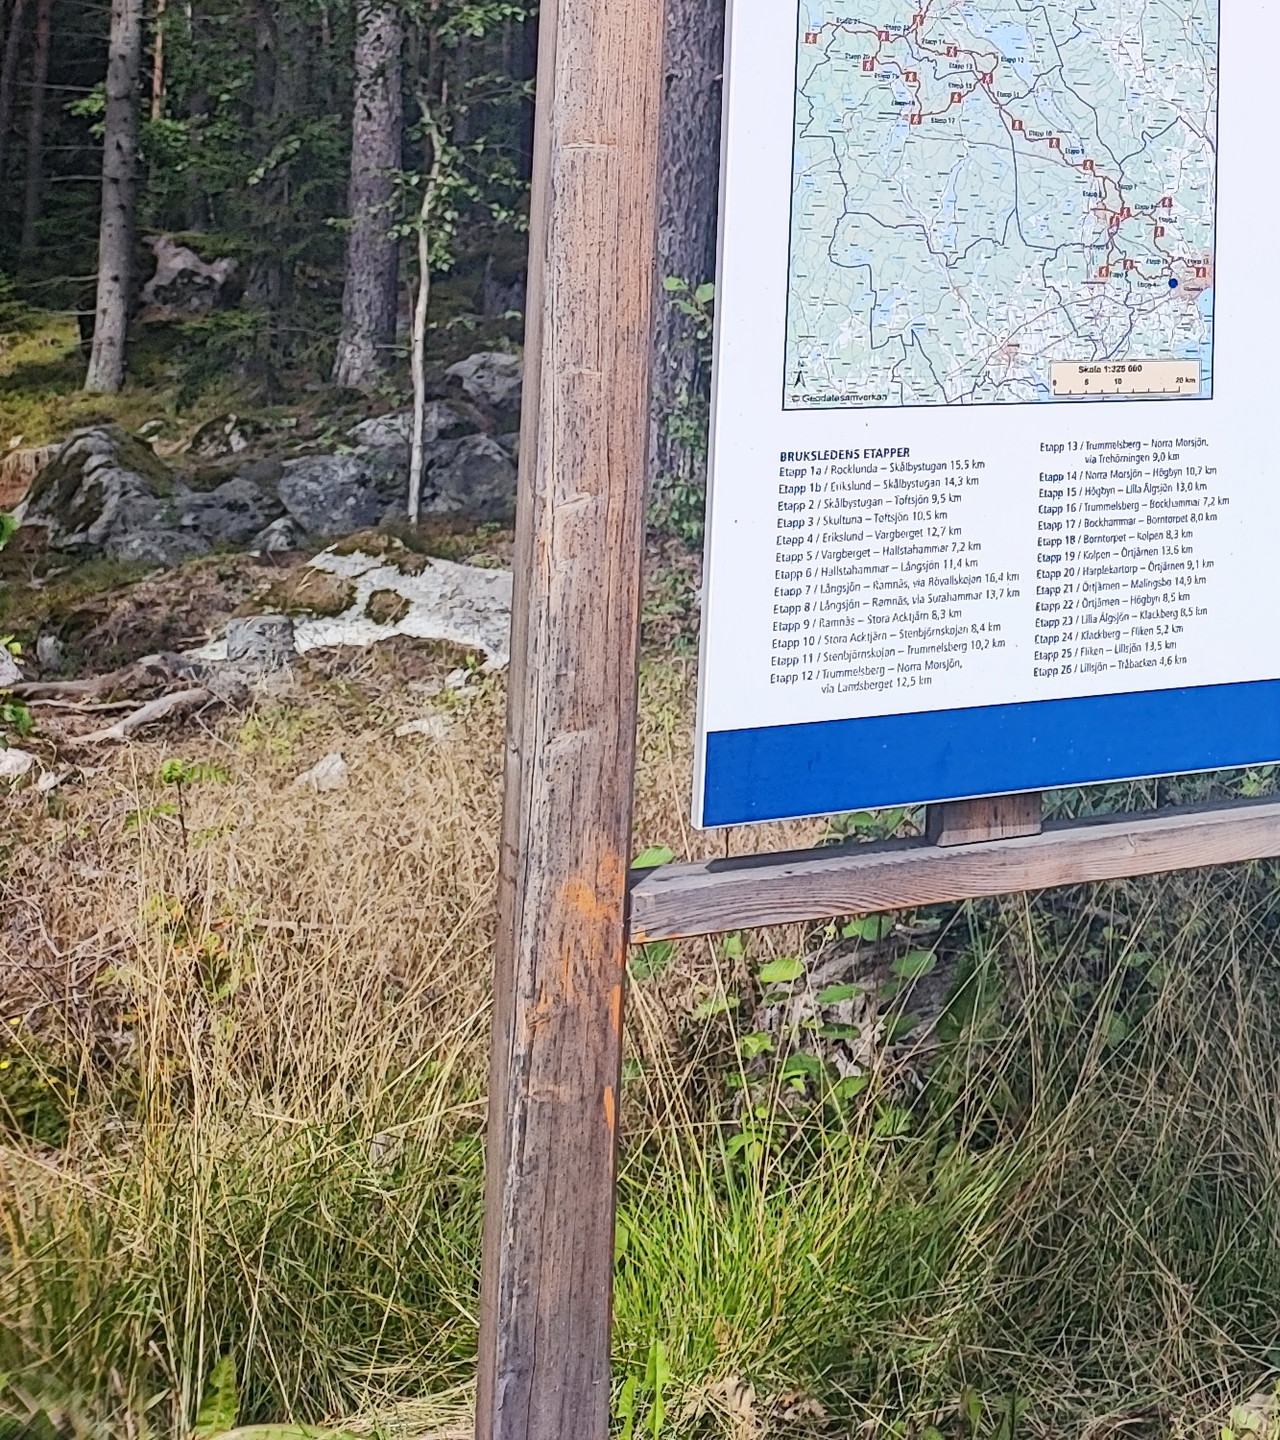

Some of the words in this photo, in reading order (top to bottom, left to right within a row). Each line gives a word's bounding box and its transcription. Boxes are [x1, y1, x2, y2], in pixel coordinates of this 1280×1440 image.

[780, 448, 860, 462] BRUKSLEDENS
[863, 447, 910, 459] ETAPPER
[779, 466, 807, 479] Etapp
[830, 463, 878, 475] Rocklunda
[889, 461, 947, 474] Skålbystugan
[971, 458, 985, 469] km
[778, 483, 806, 496] Etapp
[809, 482, 822, 492] 1b
[830, 479, 872, 492] Erikslund
[883, 478, 940, 490] Skålbystugan
[966, 475, 979, 485] km
[777, 500, 806, 513] Etapp
[808, 499, 814, 510] 2
[823, 497, 883, 509] Skålbystugan
[894, 494, 929, 507] Toftsjön
[931, 493, 946, 505] 9,5
[948, 492, 962, 503] km
[776, 535, 804, 547] Etapp
[806, 533, 813, 543] 4
[822, 530, 864, 543] Erikslund
[874, 528, 923, 542] Vargberget
[927, 526, 946, 538] 12,7
[948, 525, 962, 536] km
[775, 552, 804, 564] Etapp
[806, 550, 812, 561] 5
[820, 548, 870, 562] Vargberget
[882, 544, 949, 556] Hallstahammar
[951, 541, 966, 553] 7,2
[968, 541, 981, 551] km
